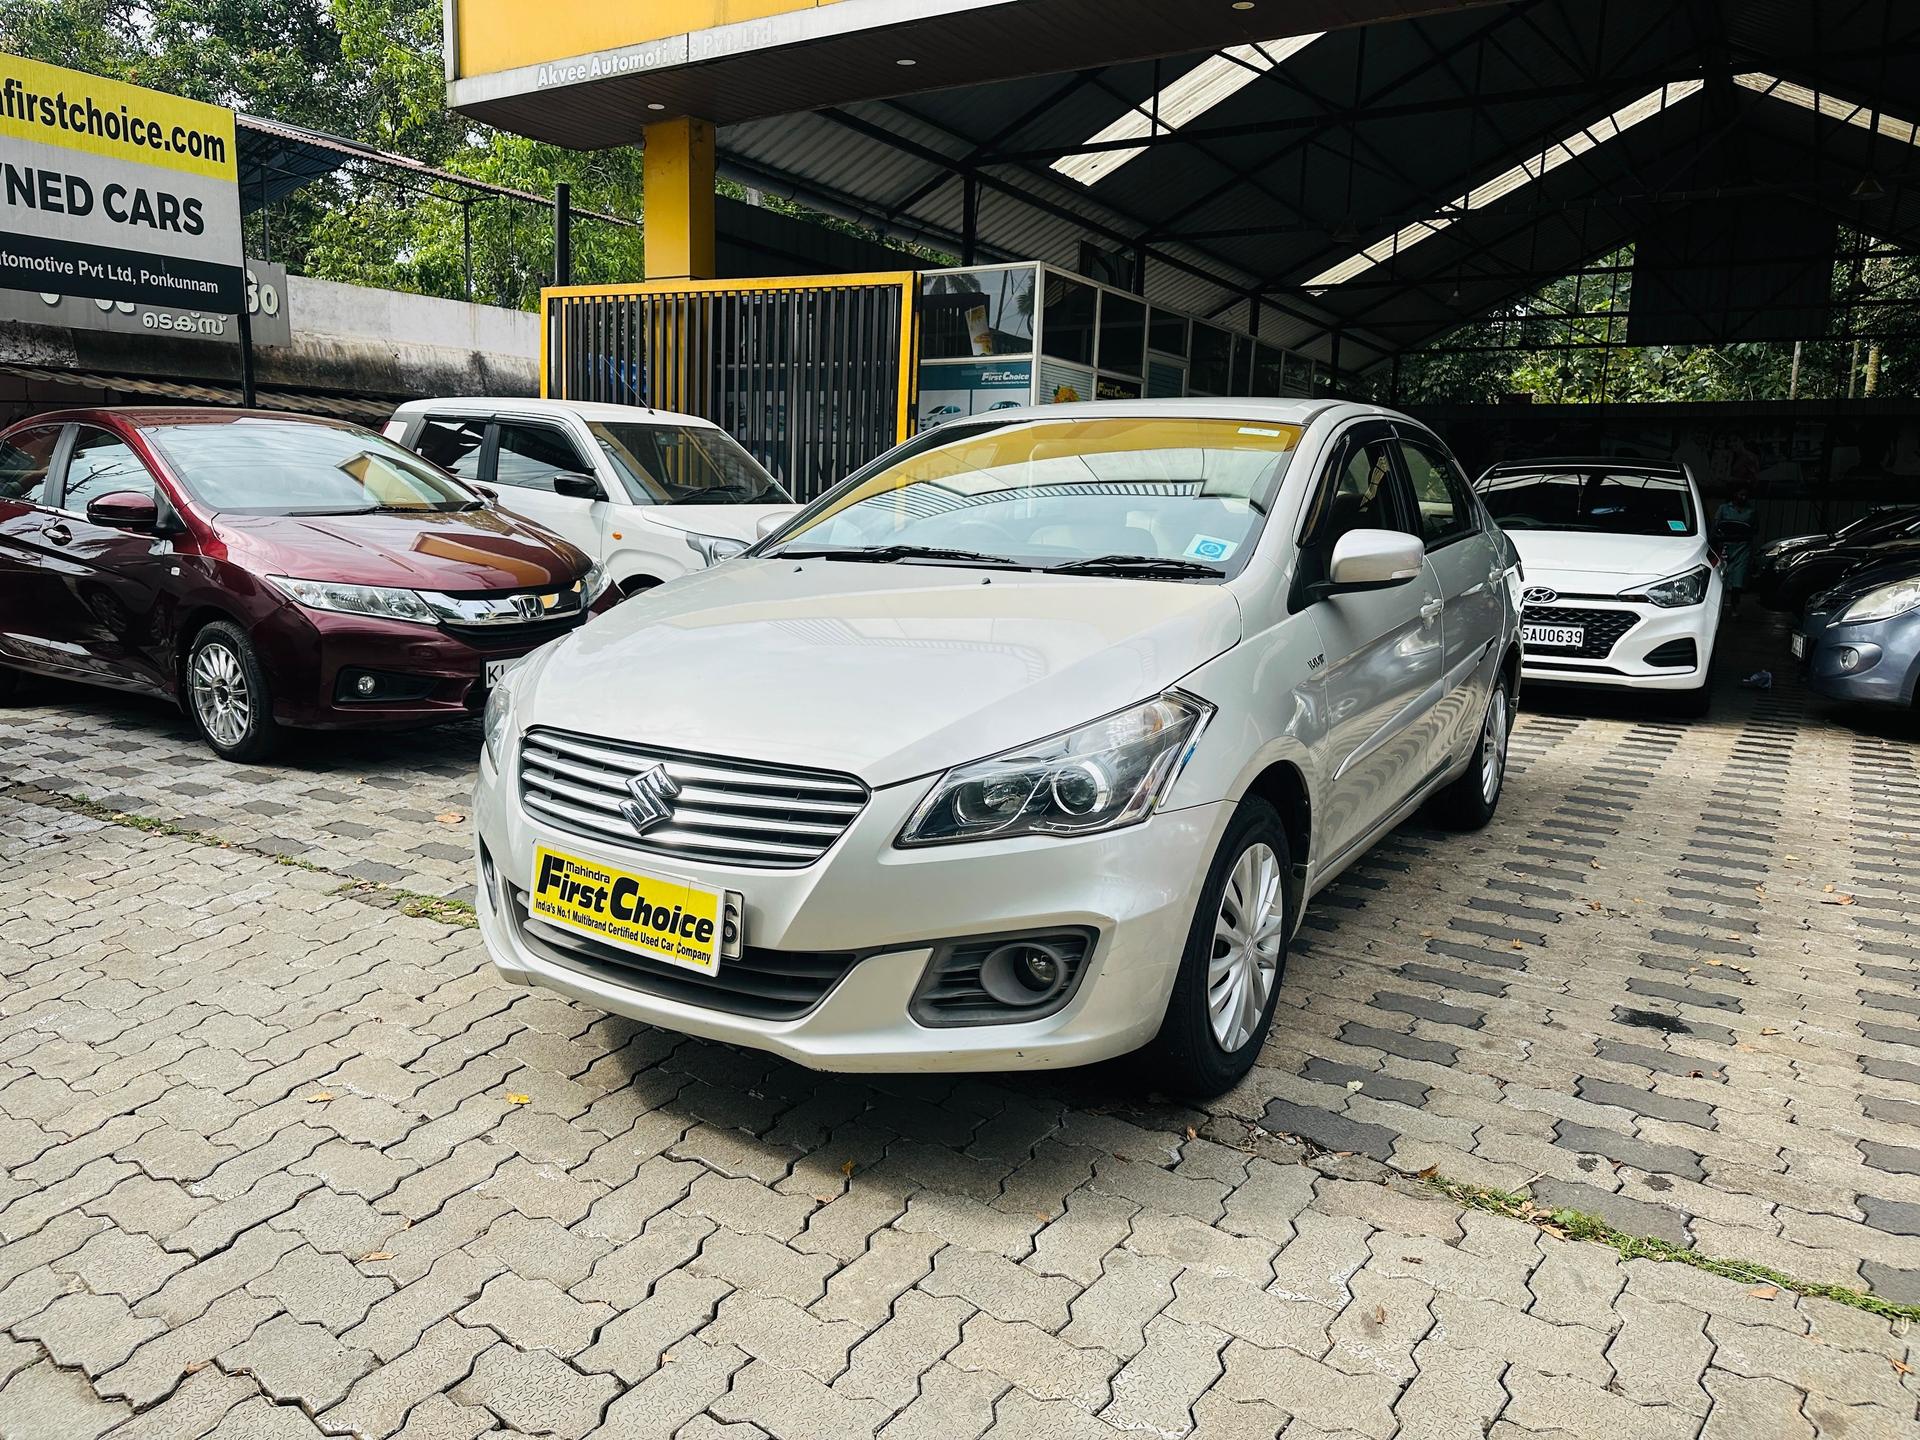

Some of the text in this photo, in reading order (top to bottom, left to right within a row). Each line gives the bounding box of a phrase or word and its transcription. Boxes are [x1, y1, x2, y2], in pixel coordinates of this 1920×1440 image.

[538, 65, 585, 87] Akvee
[590, 43, 697, 77] Automotives
[0, 162, 205, 235] NED CARS
[0, 250, 219, 294] tomotive Pvt Ltd, Ponkunnam
[1523, 627, 1582, 644] 5AU0639
[536, 898, 711, 965] India's No.1 Multibrand Certified Used Car Company
